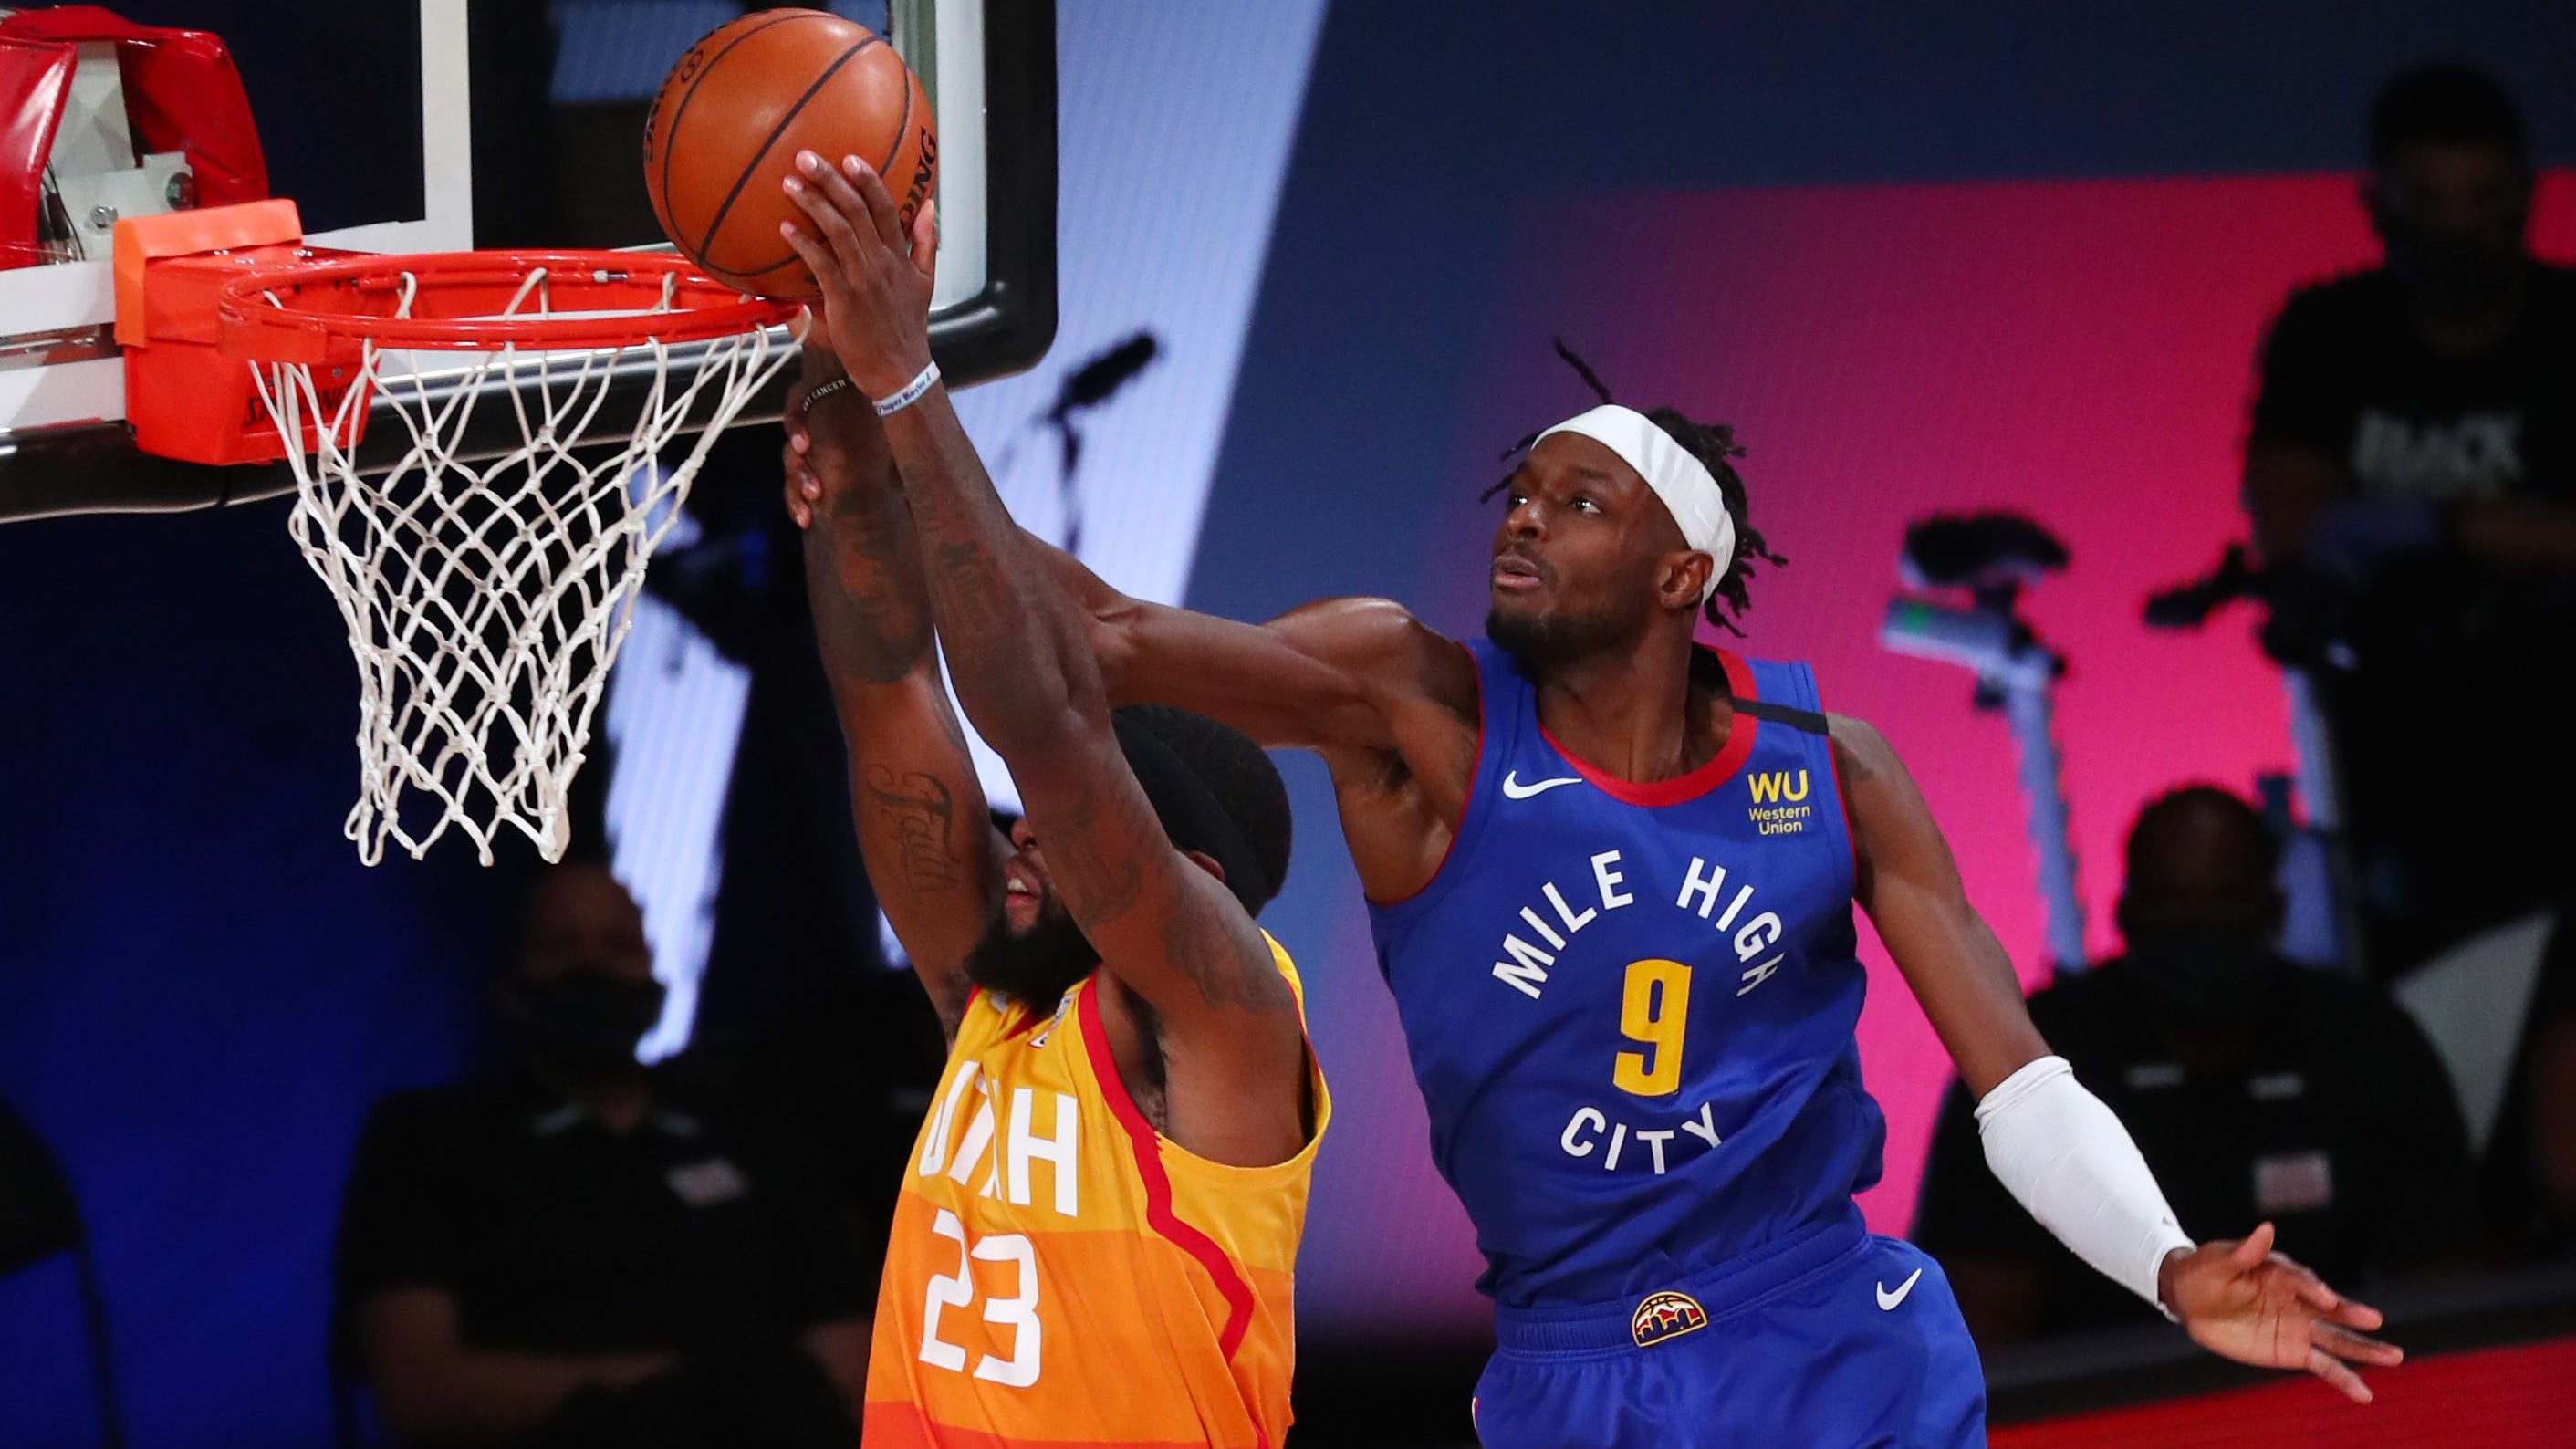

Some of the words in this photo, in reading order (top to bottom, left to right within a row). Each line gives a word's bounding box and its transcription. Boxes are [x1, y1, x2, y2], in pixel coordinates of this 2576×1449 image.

[1748, 769, 1809, 805] WU
[1748, 806, 1810, 821] Western
[1758, 820, 1802, 836] Union
[1491, 849, 1634, 1001] MILE
[1675, 855, 1786, 998] HIGH
[1612, 958, 1693, 1098] 9
[1560, 1100, 1723, 1176] CITY
[918, 1207, 1042, 1389] 23
